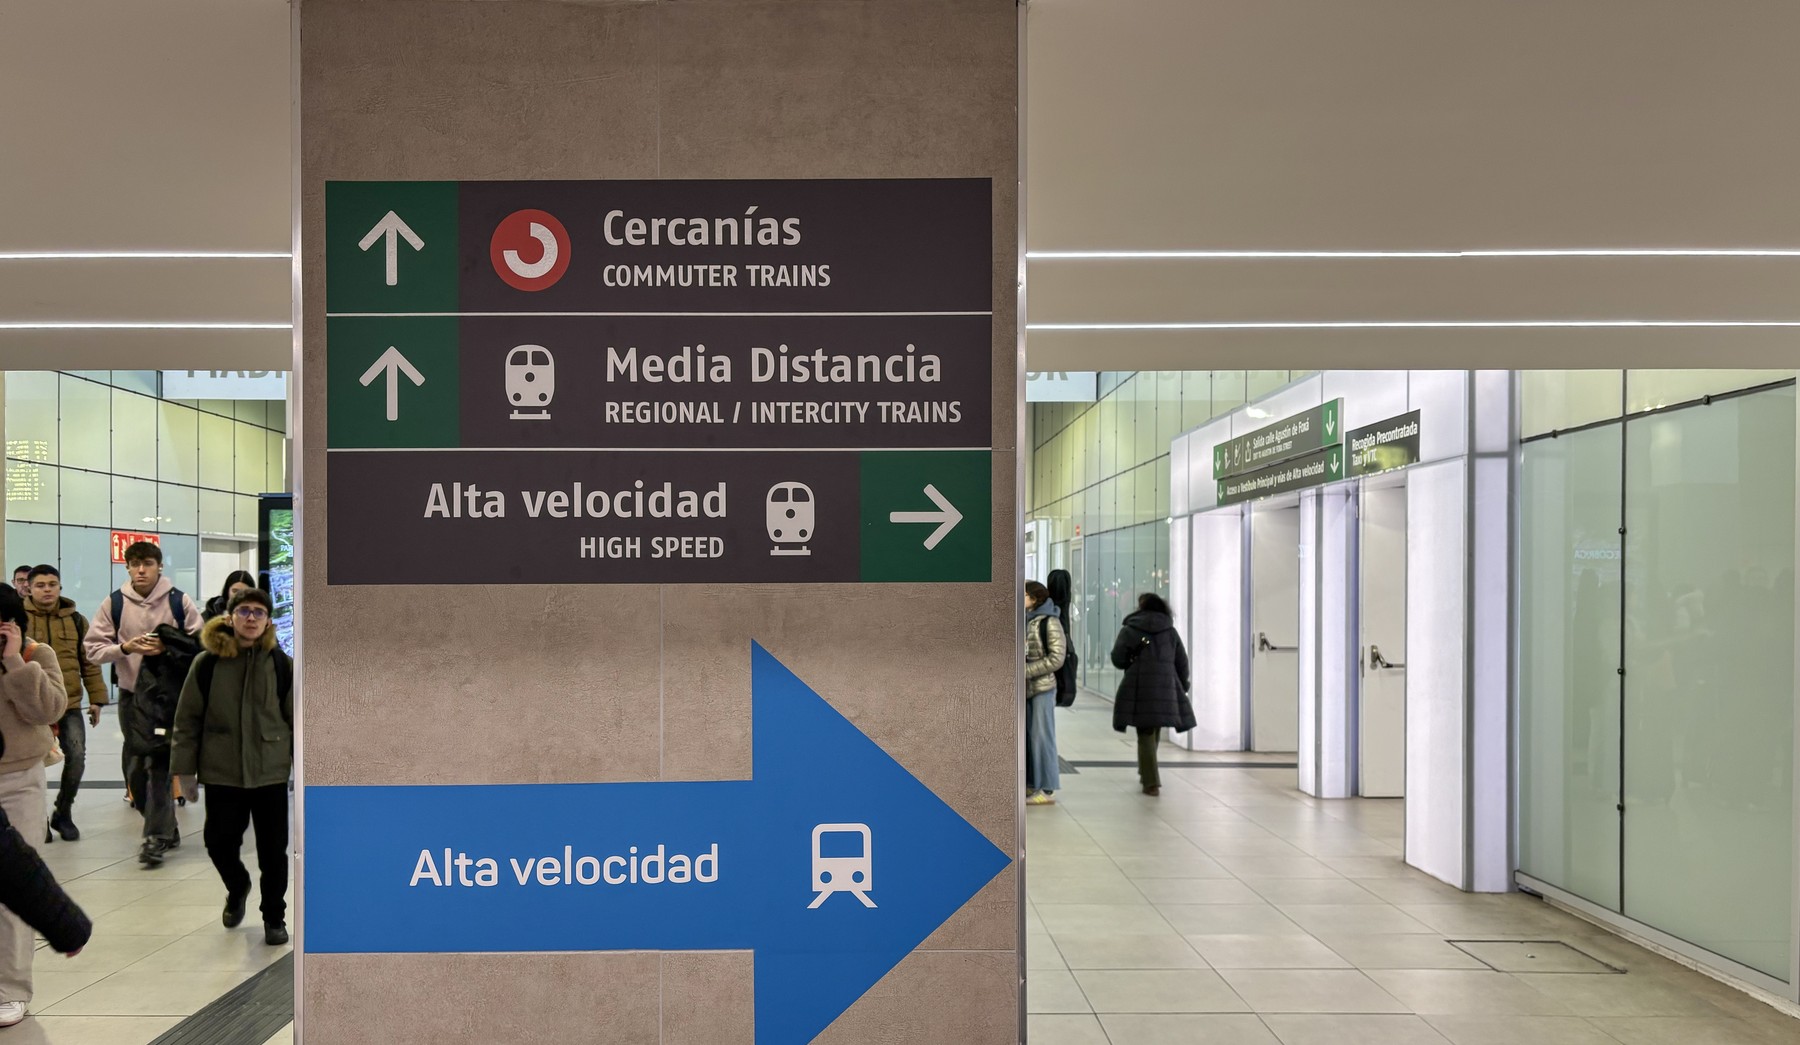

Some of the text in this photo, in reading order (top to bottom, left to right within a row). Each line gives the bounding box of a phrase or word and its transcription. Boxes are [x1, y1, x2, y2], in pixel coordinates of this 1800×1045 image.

[603, 205, 801, 246] Cercanías
[603, 264, 831, 287] COMMUTER TRAINS
[606, 343, 941, 383] Media Distancia
[605, 401, 962, 424] REGIONAL / INTERCITY TRAINS
[1253, 435, 1264, 449] Salida
[1266, 432, 1274, 445] calle
[1276, 425, 1291, 443] Agustín
[1292, 424, 1298, 436] de
[1351, 421, 1418, 451] Recogida Precontratada
[1352, 448, 1377, 467] Taxi y VTC
[1256, 474, 1273, 489] Principal
[1273, 476, 1278, 487] y
[1286, 470, 1292, 480] de
[1292, 468, 1302, 480] Alta
[1302, 460, 1324, 477] velocidad
[423, 479, 727, 518] Alta velocidad
[580, 536, 724, 559] HIGH SPEED
[409, 843, 719, 887] Alta velocidad
